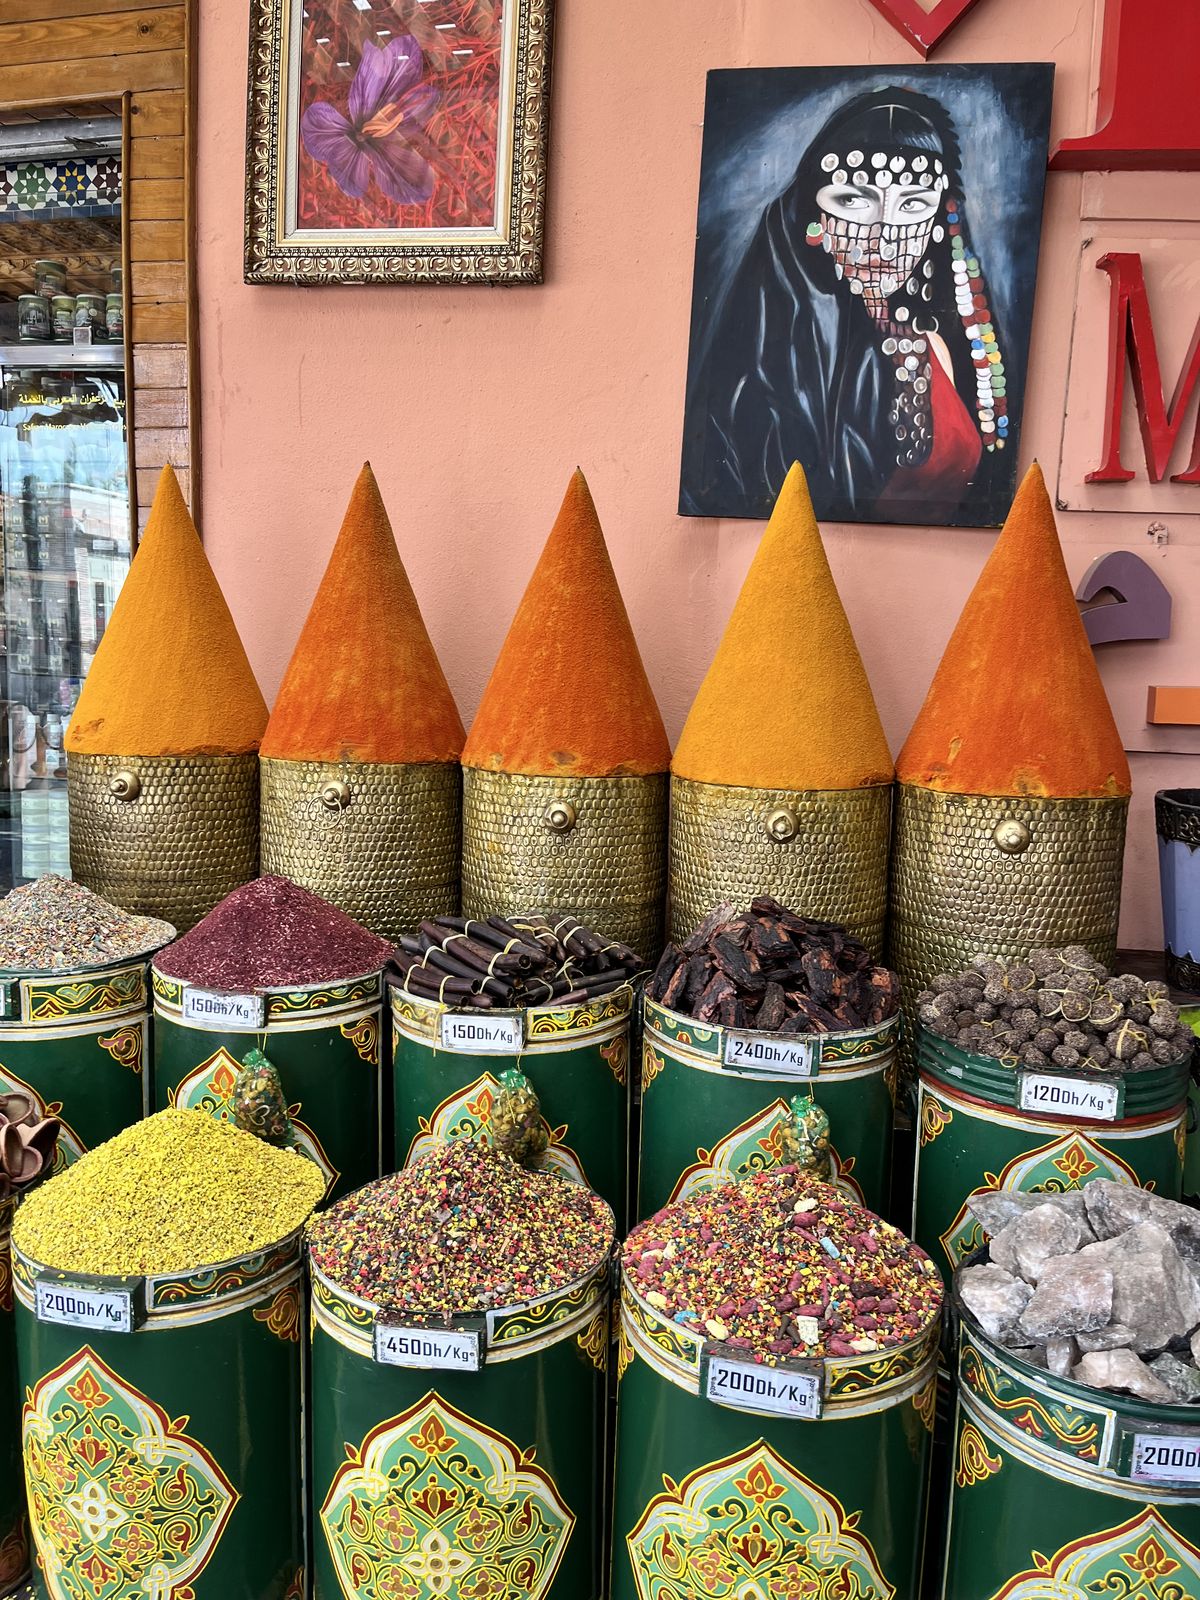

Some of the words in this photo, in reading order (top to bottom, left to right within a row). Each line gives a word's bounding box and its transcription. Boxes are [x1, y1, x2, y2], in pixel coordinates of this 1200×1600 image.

[452, 1024, 513, 1044] 150Dh/Kg
[734, 1041, 804, 1066] 240Dh/Kg
[1033, 1084, 1104, 1111] 120Dh/Kg
[45, 1293, 122, 1322] 200Dh/Kg
[386, 1336, 469, 1362] 450Dh/Kg
[717, 1369, 807, 1406] 200Dh/Kg
[1143, 1446, 1200, 1468] 200D
